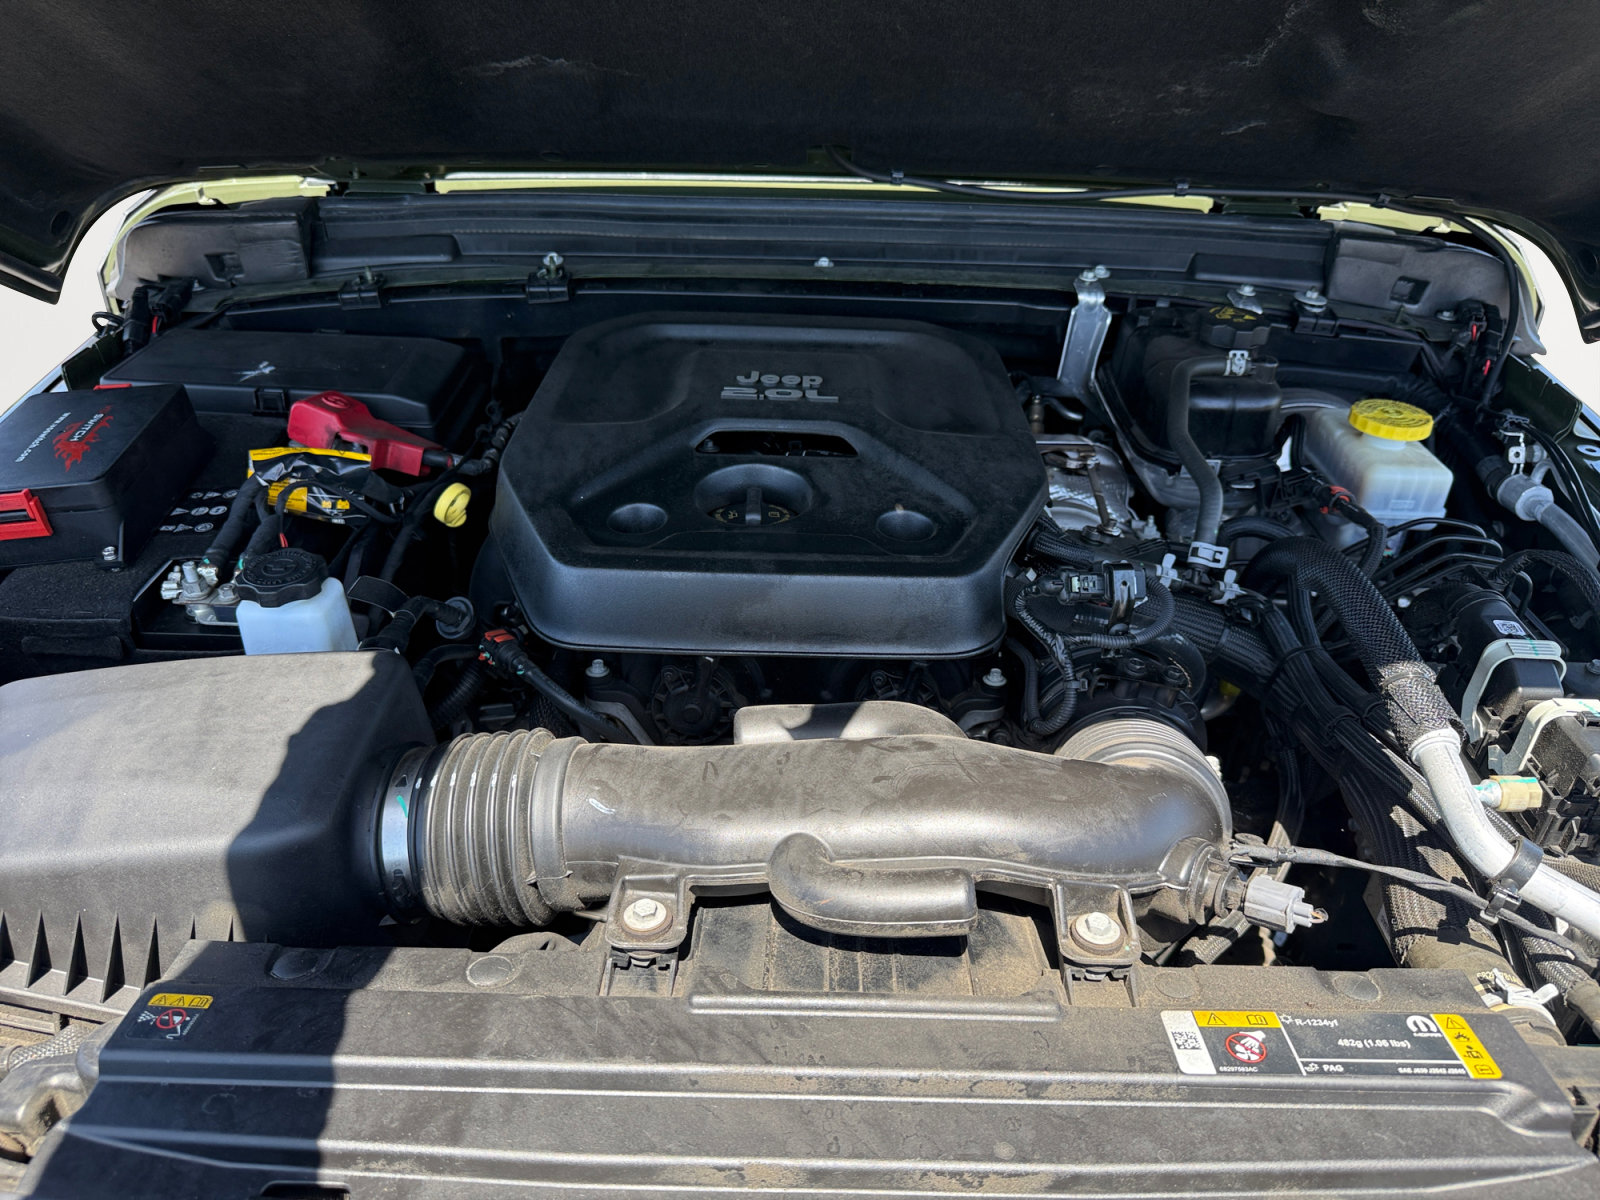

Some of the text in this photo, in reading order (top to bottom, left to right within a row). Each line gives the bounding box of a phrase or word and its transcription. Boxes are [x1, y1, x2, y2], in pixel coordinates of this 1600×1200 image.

[736, 369, 823, 389] Jeep
[721, 386, 839, 403] 2.0L
[1322, 1064, 1344, 1072] PAG
